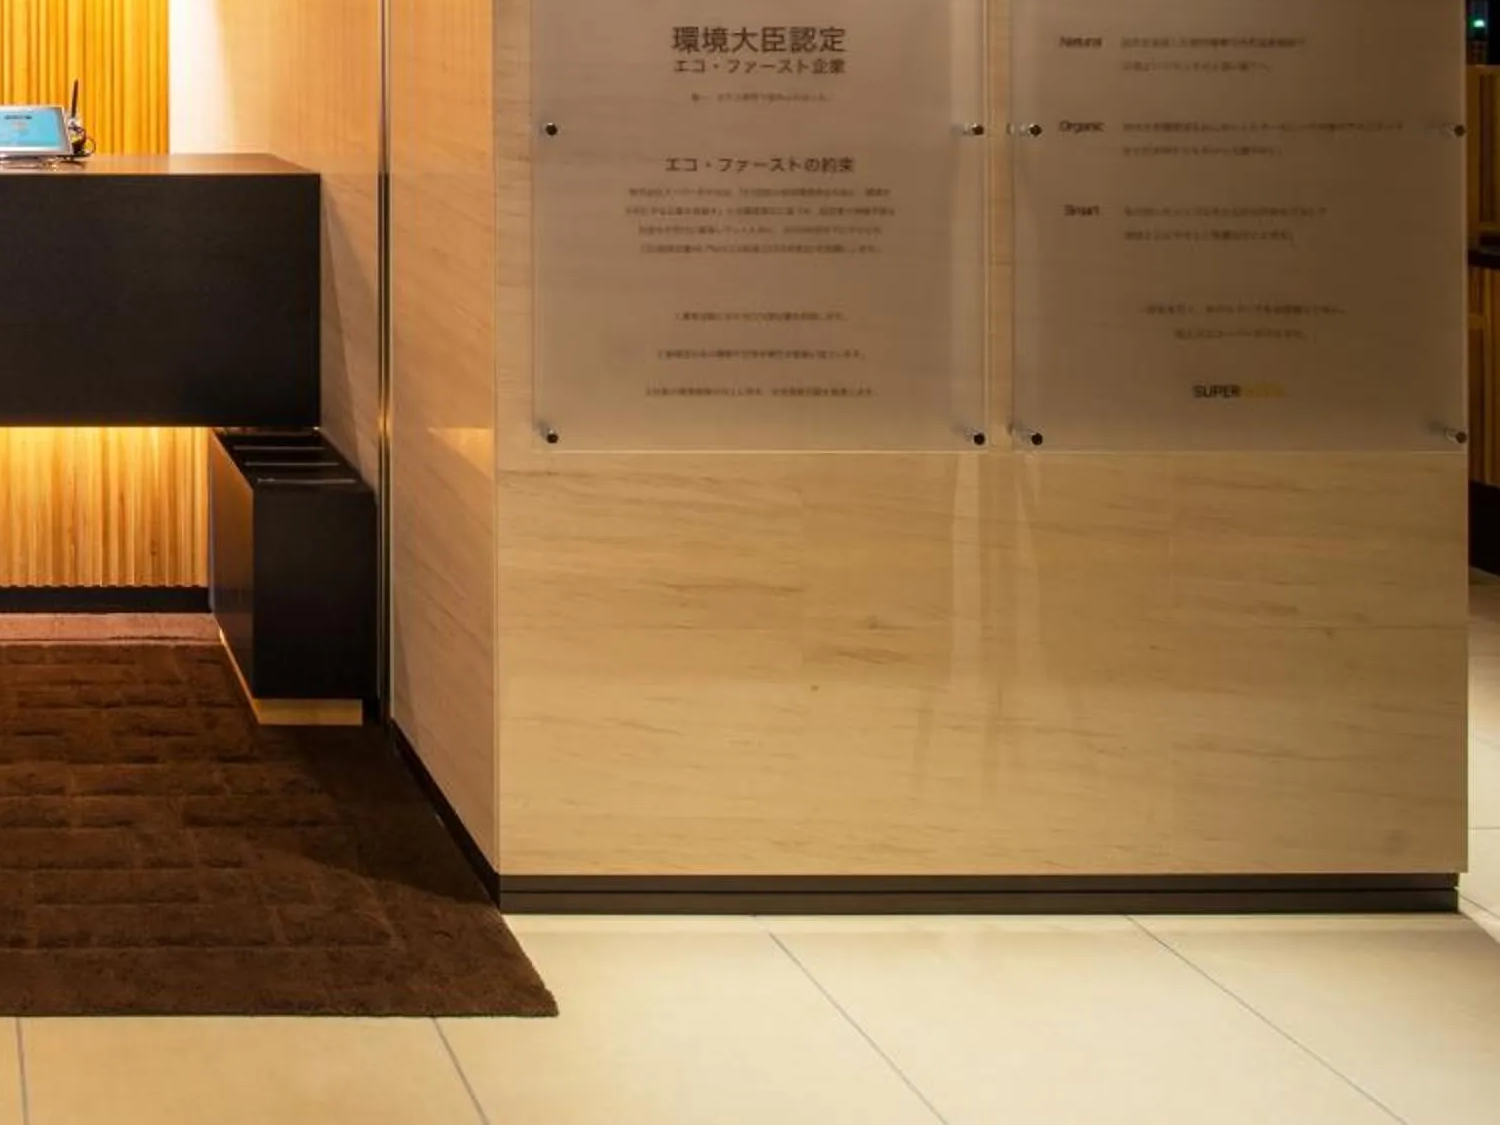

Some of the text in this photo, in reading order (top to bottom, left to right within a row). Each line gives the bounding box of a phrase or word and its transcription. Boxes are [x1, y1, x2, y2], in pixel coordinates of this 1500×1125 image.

[672, 26, 847, 54] 環境大臣認定
[673, 58, 847, 75] エコ・ファースト企業
